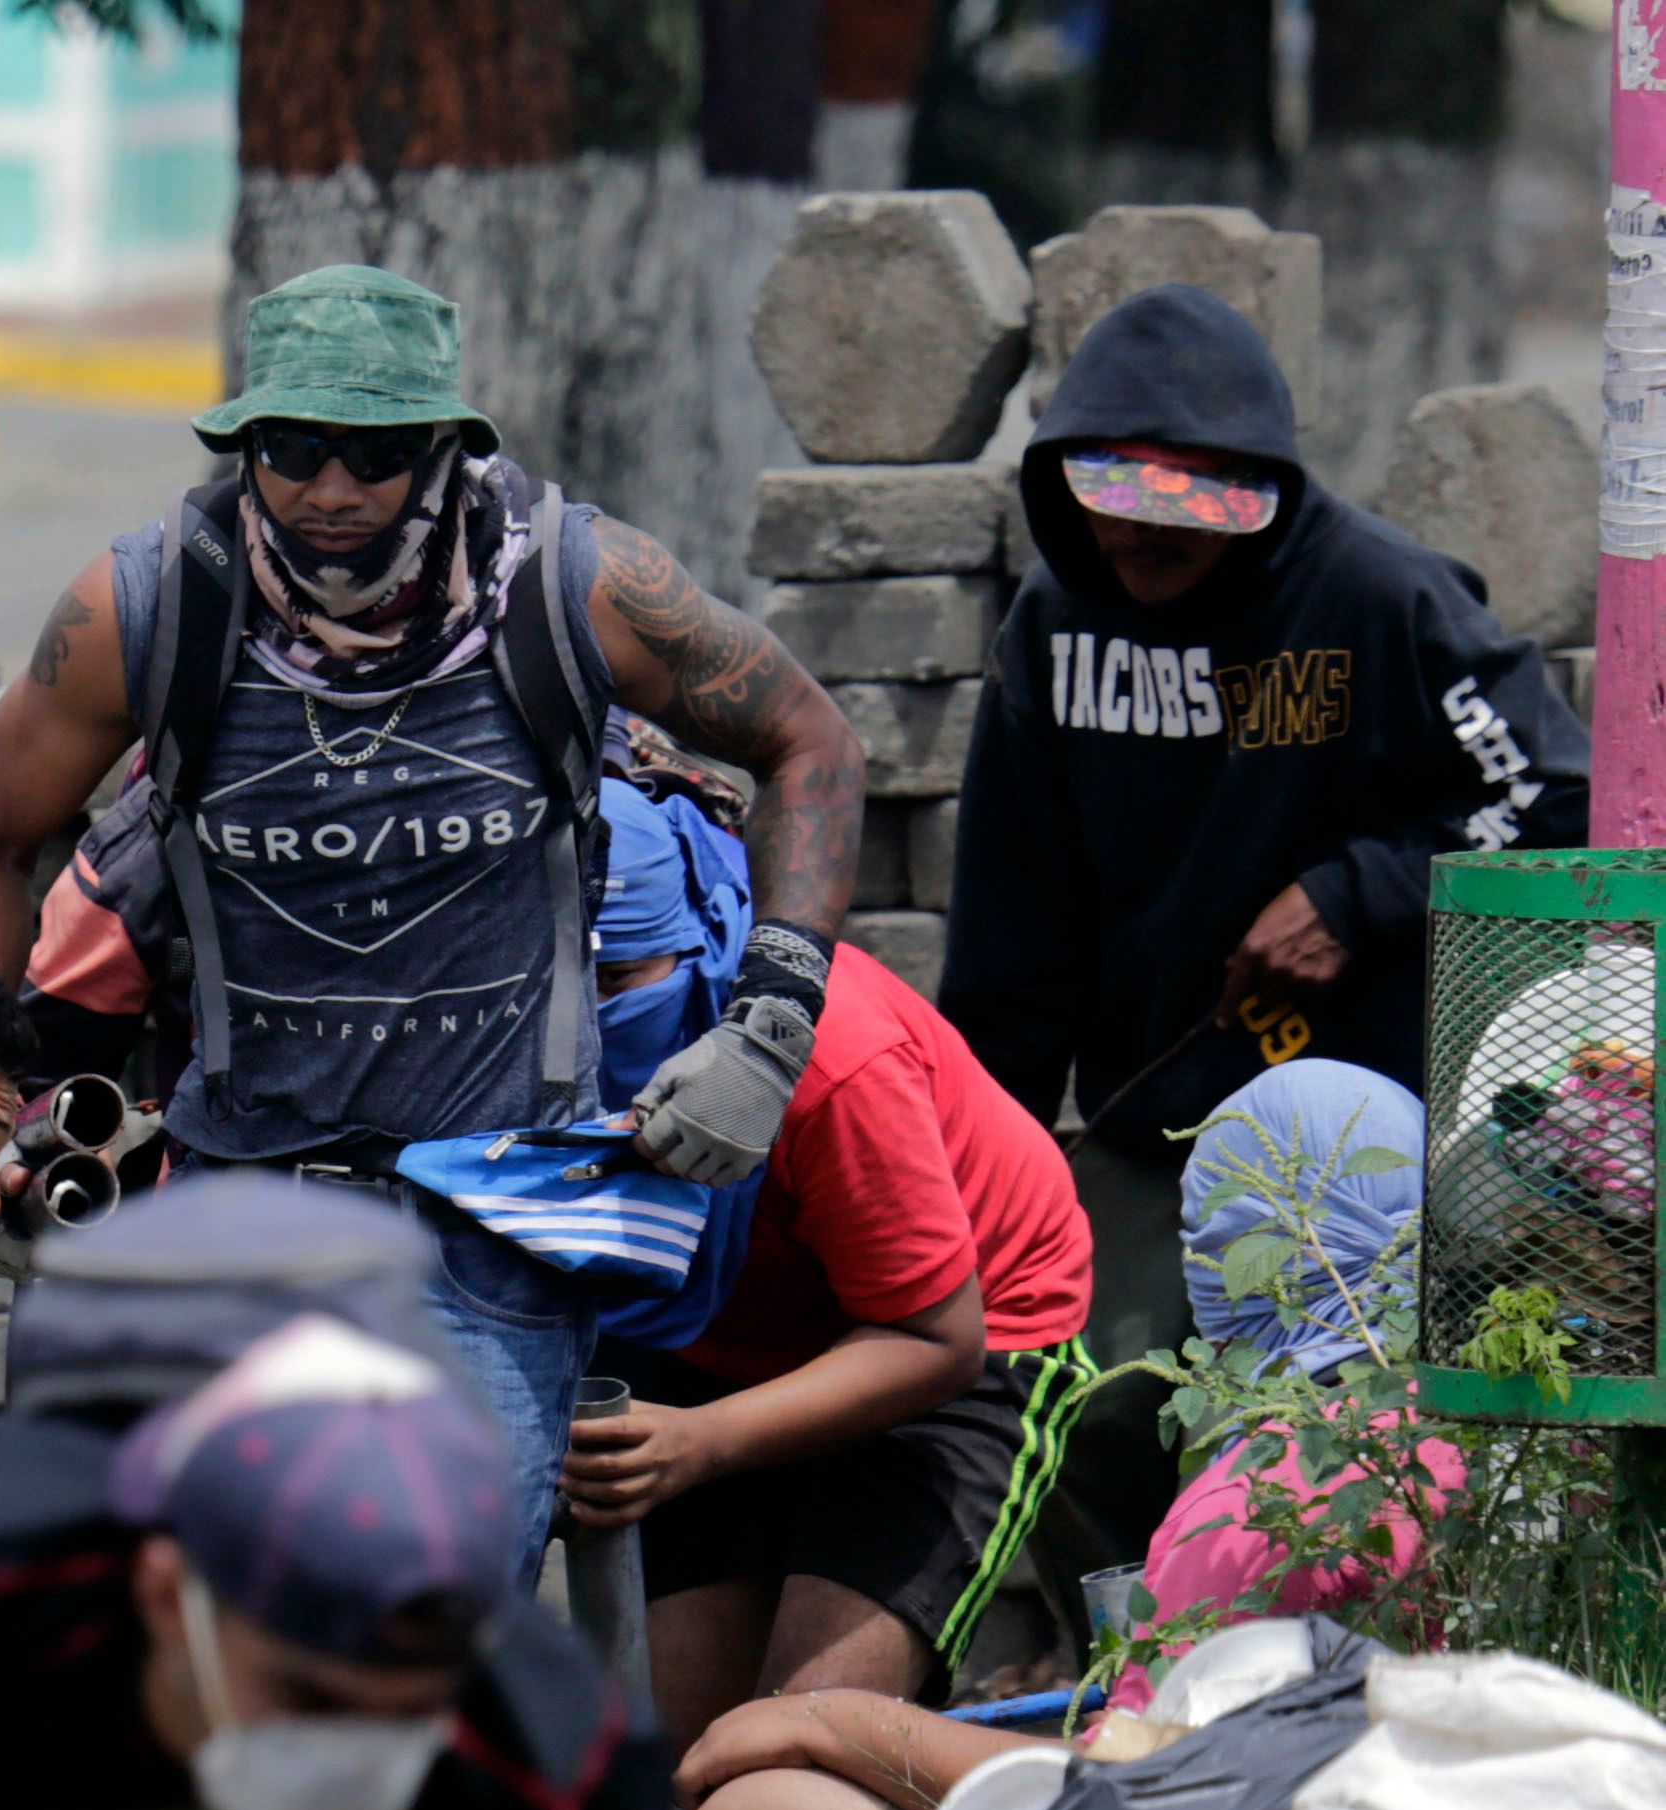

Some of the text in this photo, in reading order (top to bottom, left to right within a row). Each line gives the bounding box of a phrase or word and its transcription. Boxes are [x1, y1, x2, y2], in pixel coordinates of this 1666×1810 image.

[192, 528, 229, 566] TOTTO
[1050, 632, 1224, 739] JACOBS
[194, 796, 549, 865] AERO/1987
[226, 1000, 521, 1042] ALIFORNIA
